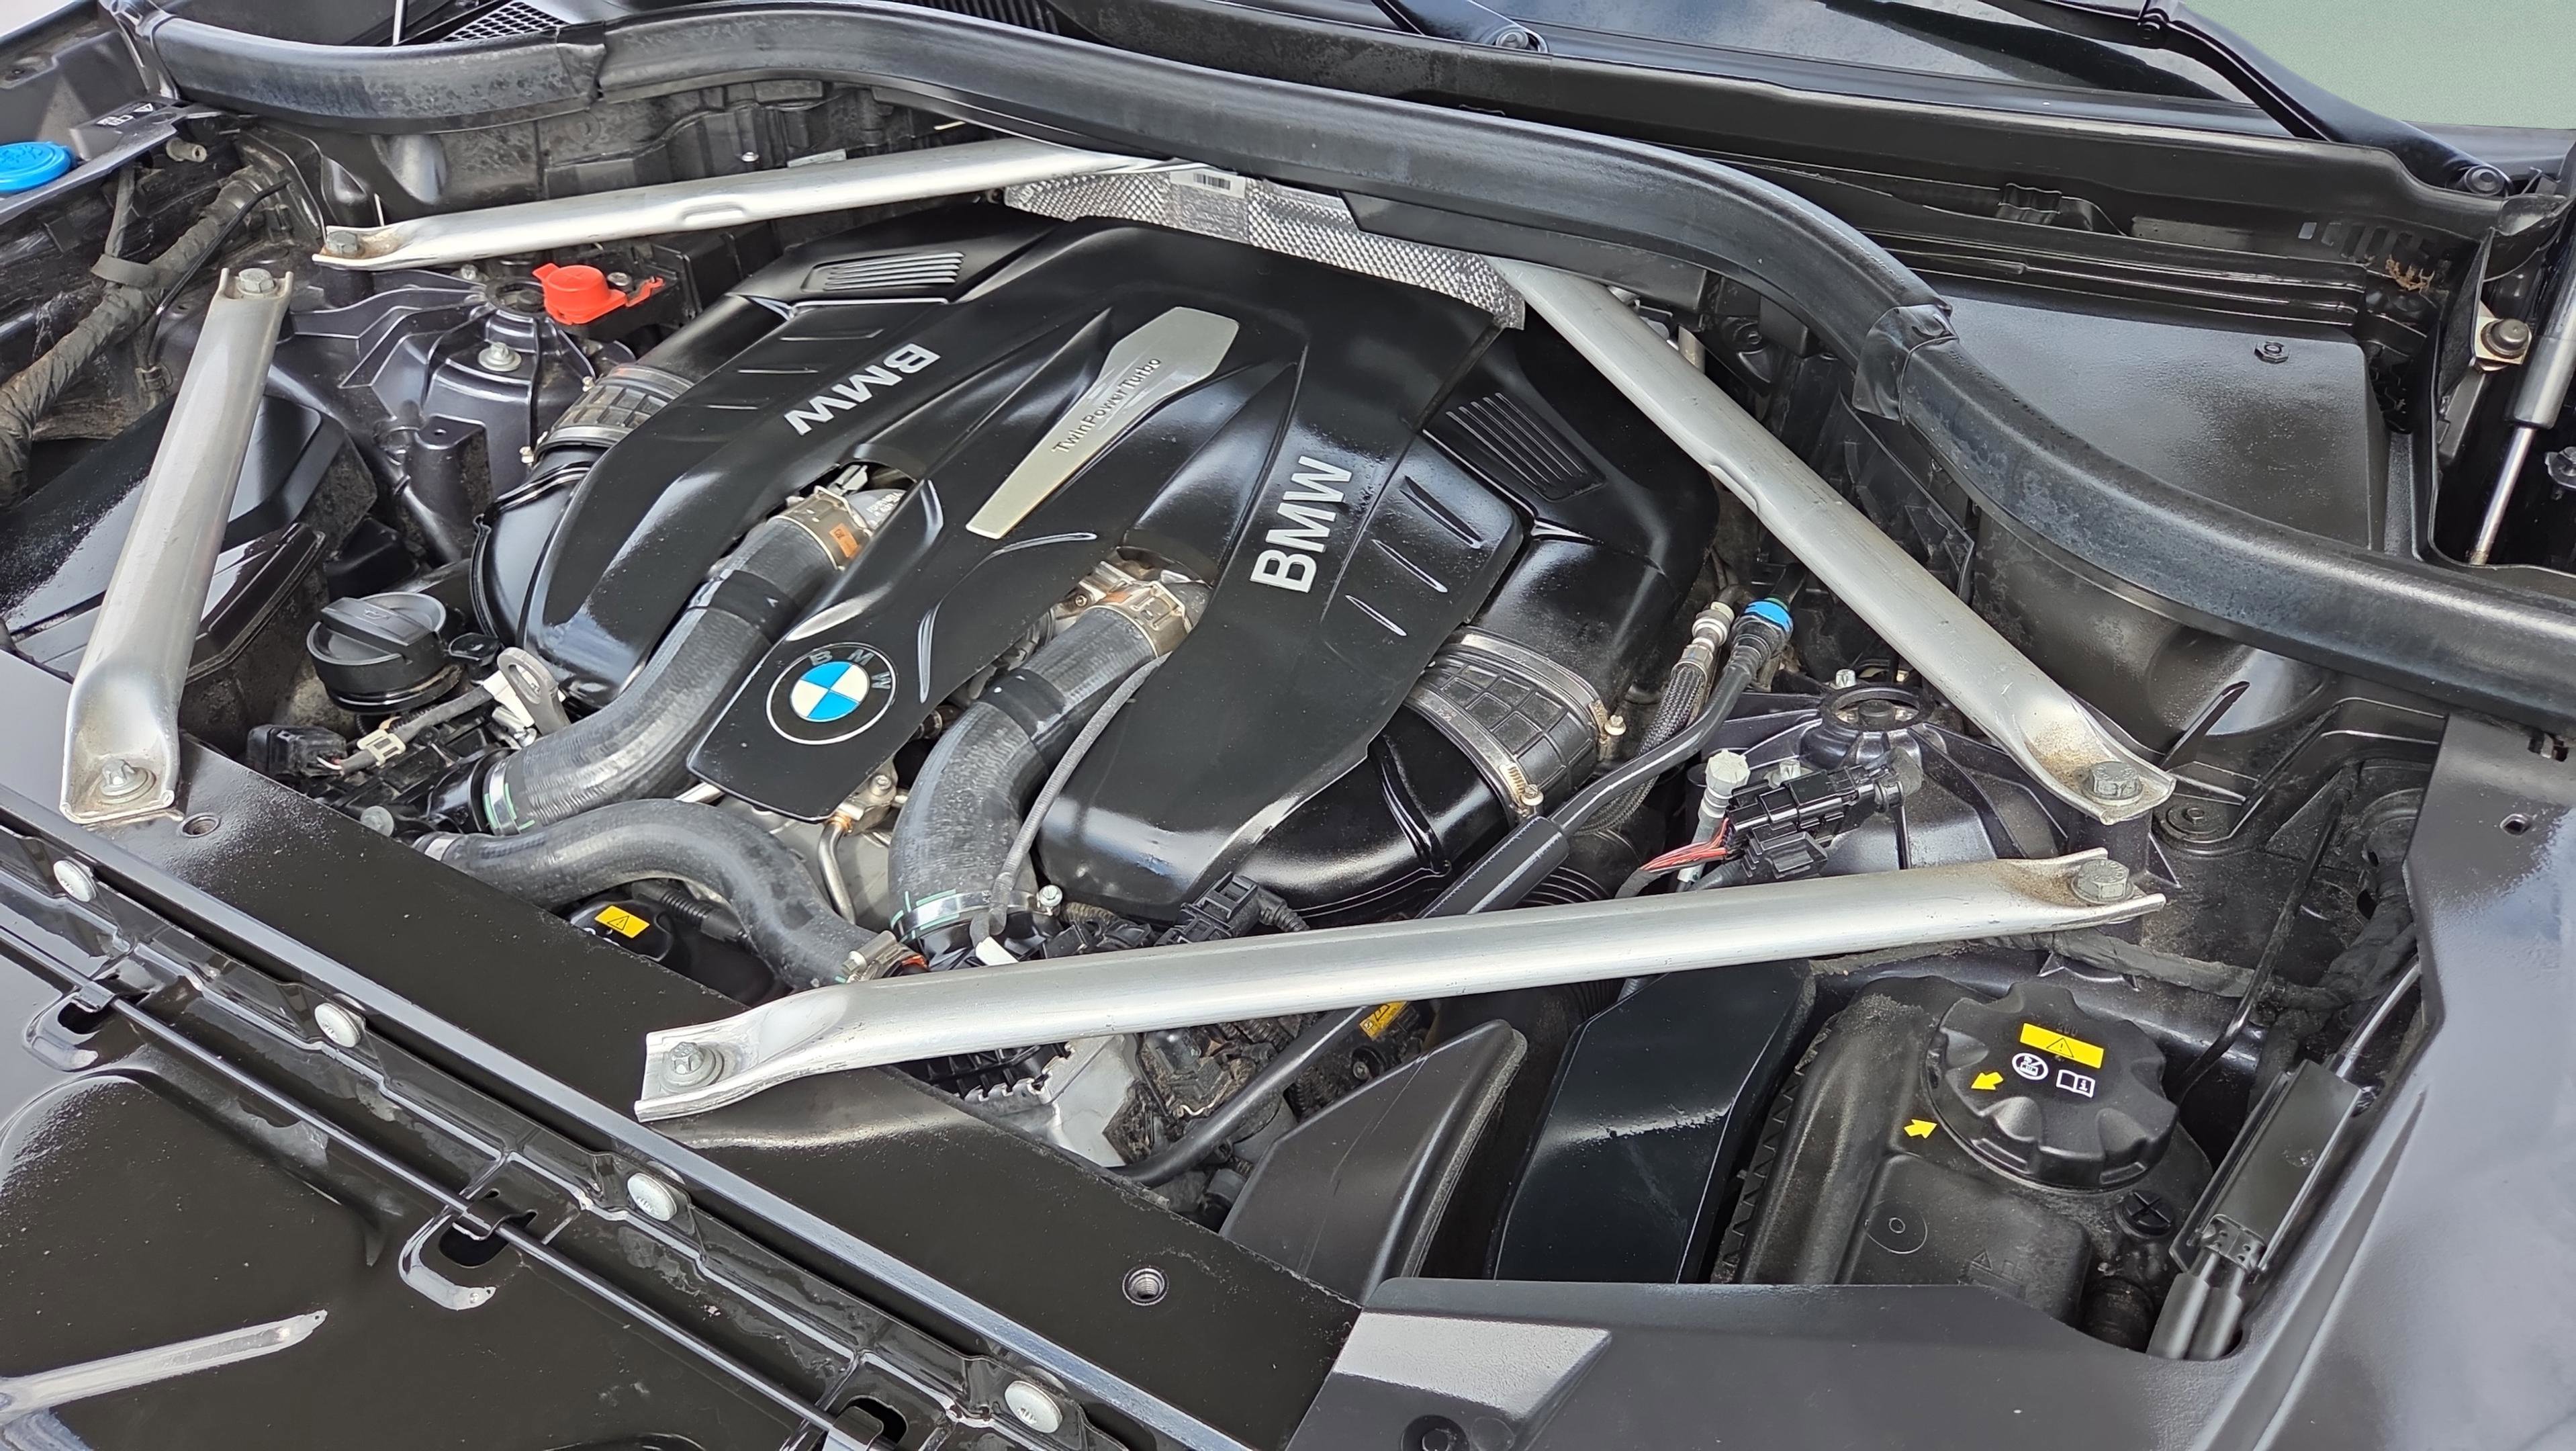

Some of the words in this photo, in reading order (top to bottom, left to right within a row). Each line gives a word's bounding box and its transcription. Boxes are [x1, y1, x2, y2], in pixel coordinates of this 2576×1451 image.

[784, 343, 941, 435] BMW
[1249, 455, 1352, 594] BMW
[809, 648, 892, 690] BMW
